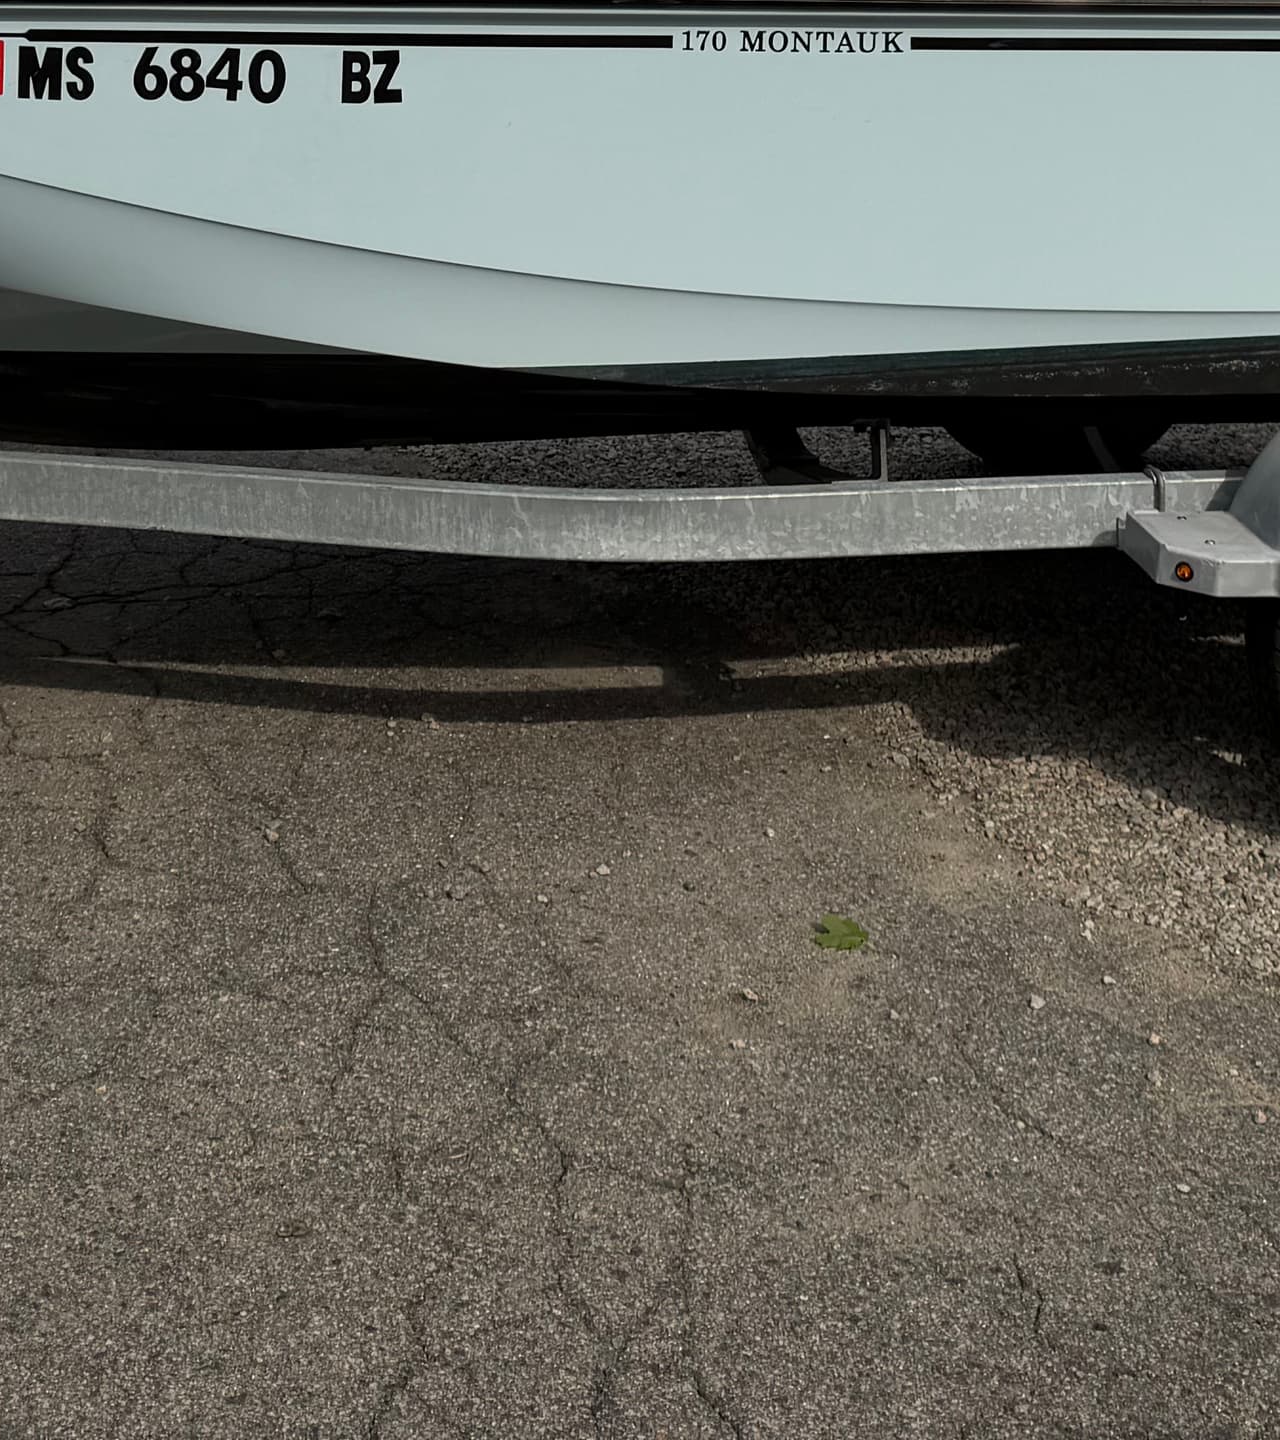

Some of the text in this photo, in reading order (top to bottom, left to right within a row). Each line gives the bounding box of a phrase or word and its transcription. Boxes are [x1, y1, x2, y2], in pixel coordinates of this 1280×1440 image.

[681, 30, 905, 53] 170 MONTAUK
[18, 46, 403, 104] MS 6840 BZ
